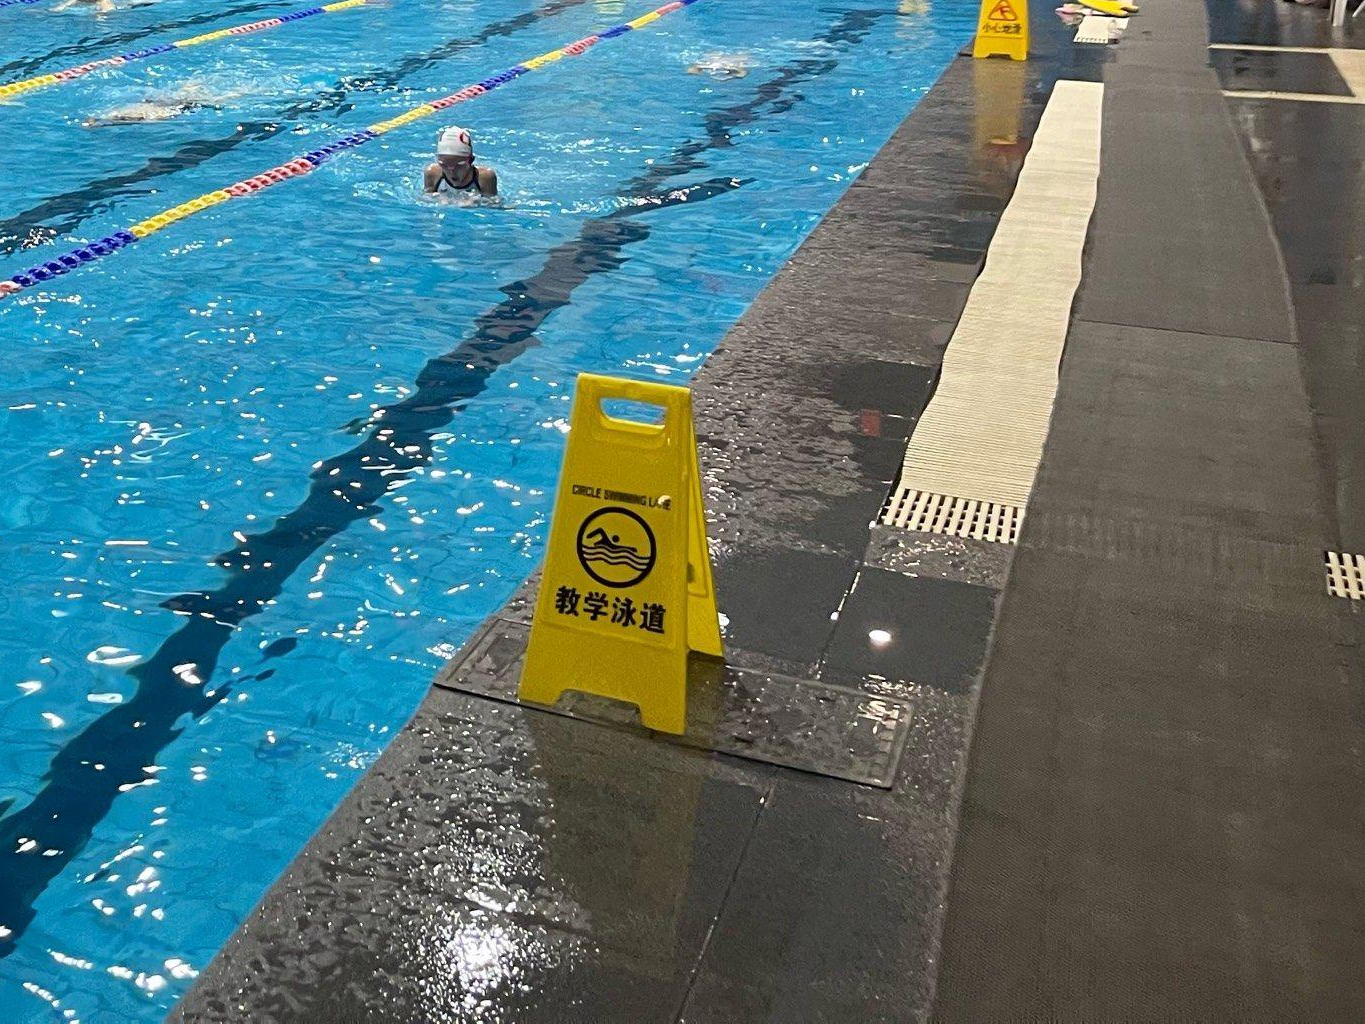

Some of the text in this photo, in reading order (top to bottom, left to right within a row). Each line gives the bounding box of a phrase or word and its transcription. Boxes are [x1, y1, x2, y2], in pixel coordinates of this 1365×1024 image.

[572, 484, 602, 499] CIRCLE
[648, 496, 671, 510] LE
[555, 585, 666, 634] 教学泳道
